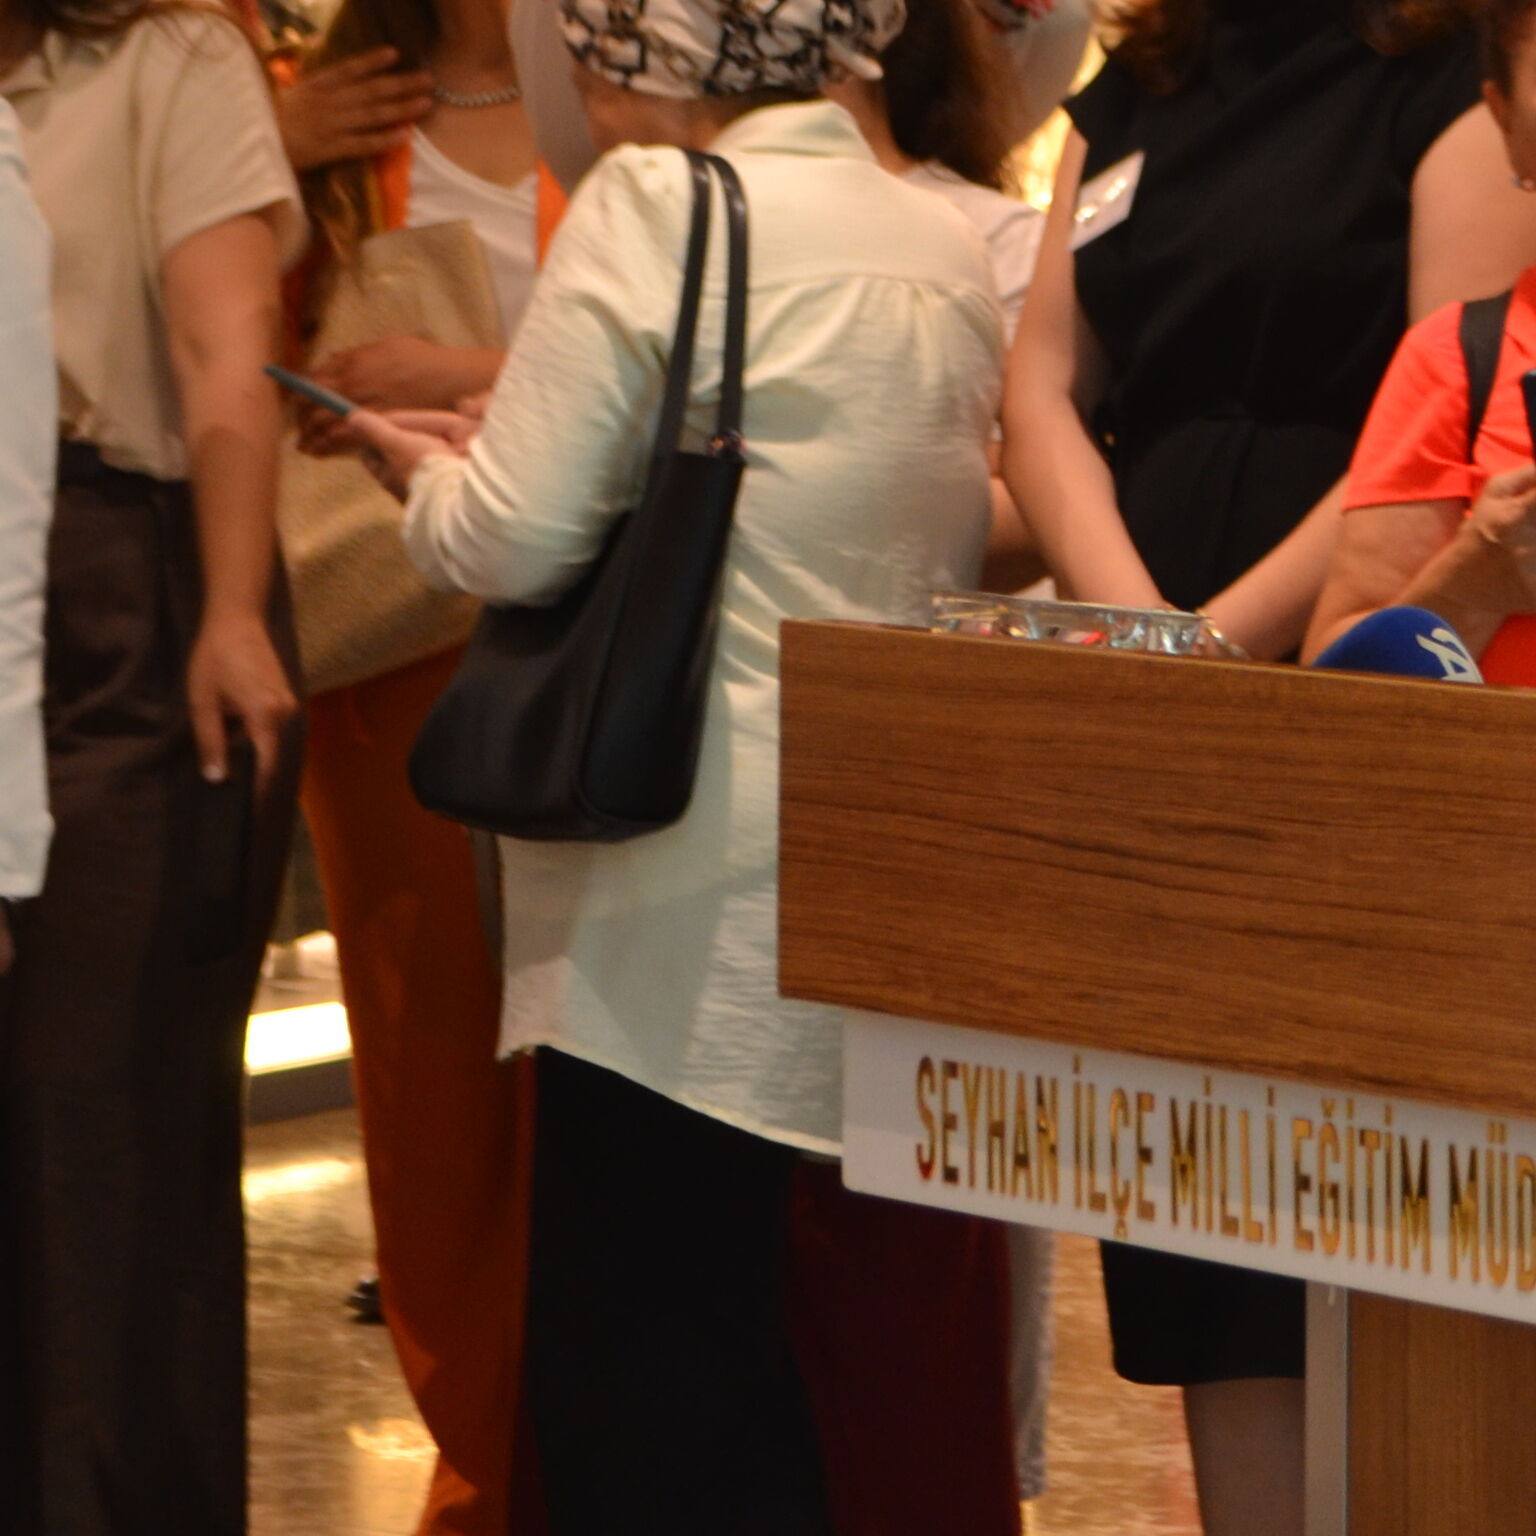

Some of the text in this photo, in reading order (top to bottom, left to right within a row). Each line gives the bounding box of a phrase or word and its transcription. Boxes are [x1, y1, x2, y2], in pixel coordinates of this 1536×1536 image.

[914, 1054, 1061, 1208] SEYHAN
[1072, 1053, 1156, 1240] İLÇE
[1168, 1075, 1279, 1248] MİLLİ
[1292, 1096, 1433, 1276] EĞİTİM
